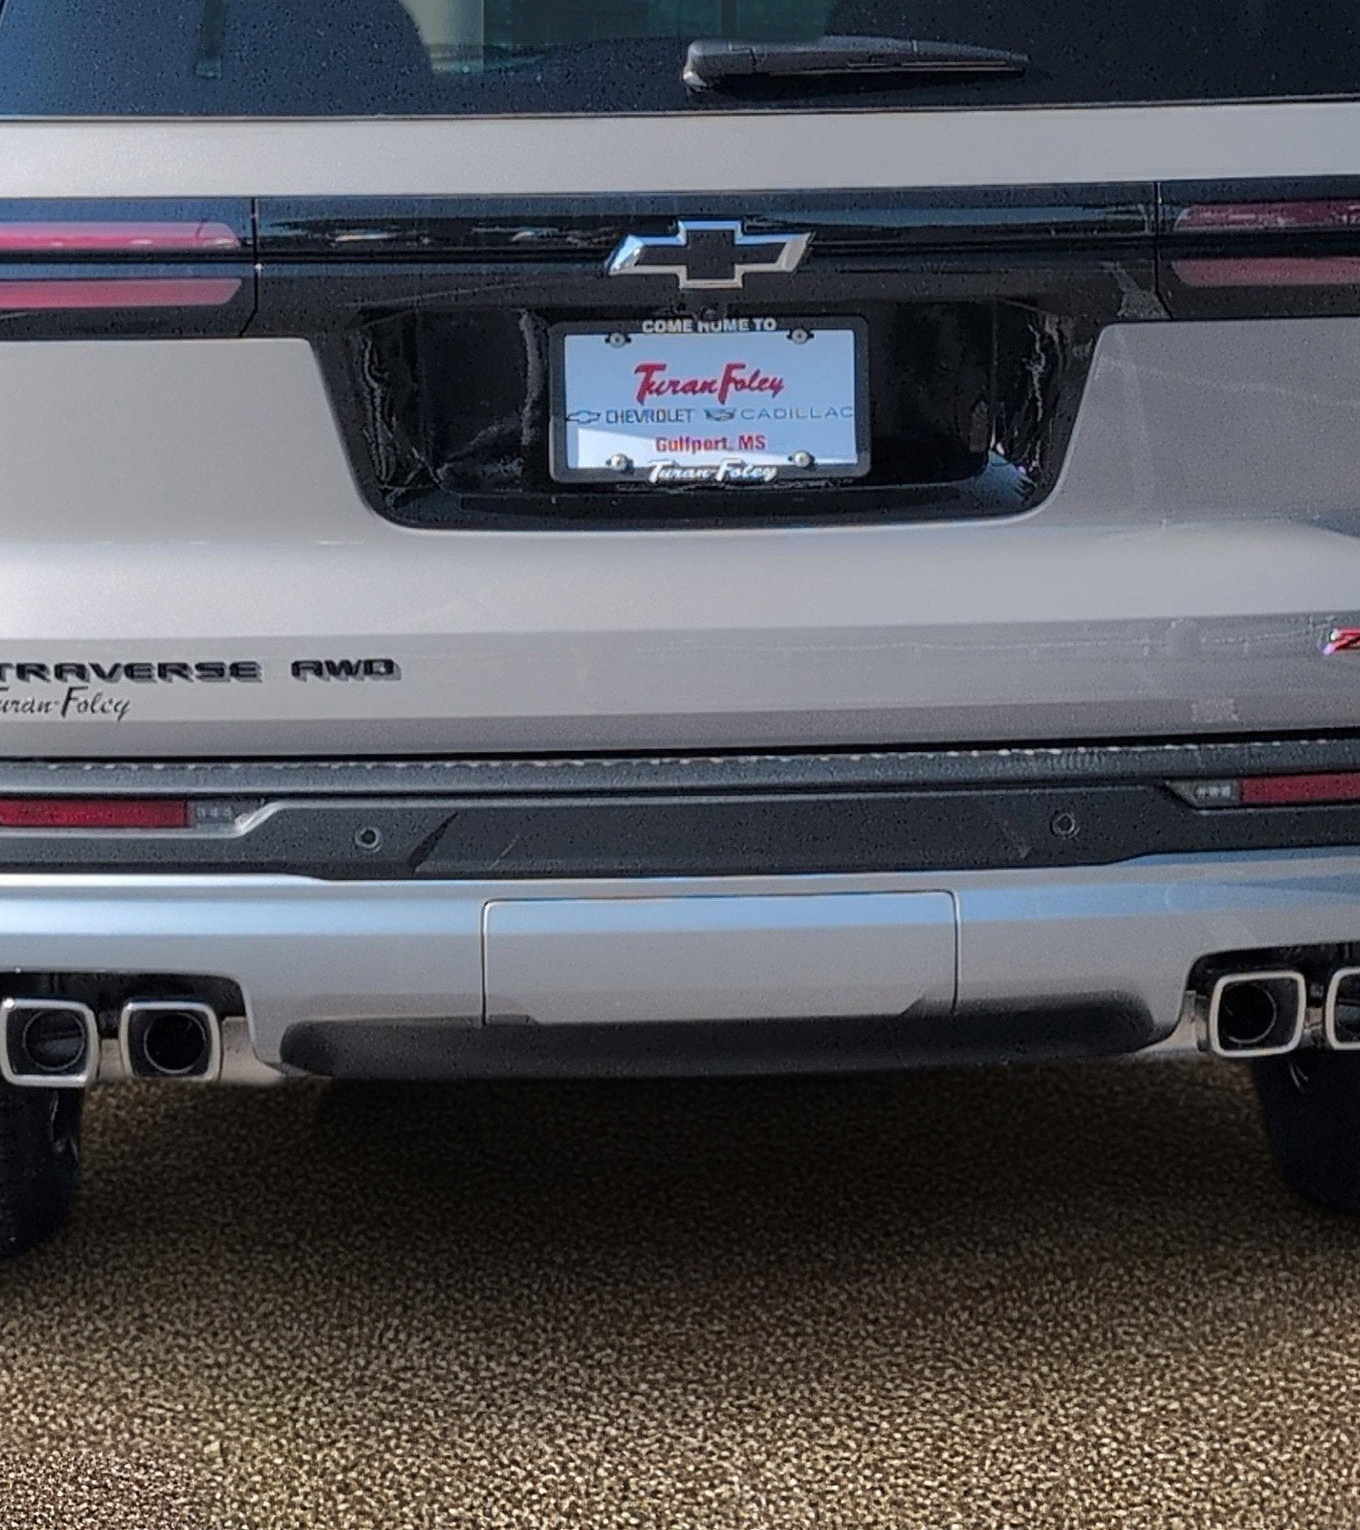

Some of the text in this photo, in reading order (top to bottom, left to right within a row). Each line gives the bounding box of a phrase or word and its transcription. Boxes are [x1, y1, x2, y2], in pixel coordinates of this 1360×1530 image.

[641, 318, 693, 333] COME
[752, 317, 777, 331] TO
[605, 406, 854, 425] CHEVROLET CADILLAC
[738, 435, 767, 451] MS
[291, 658, 402, 681] AWD
